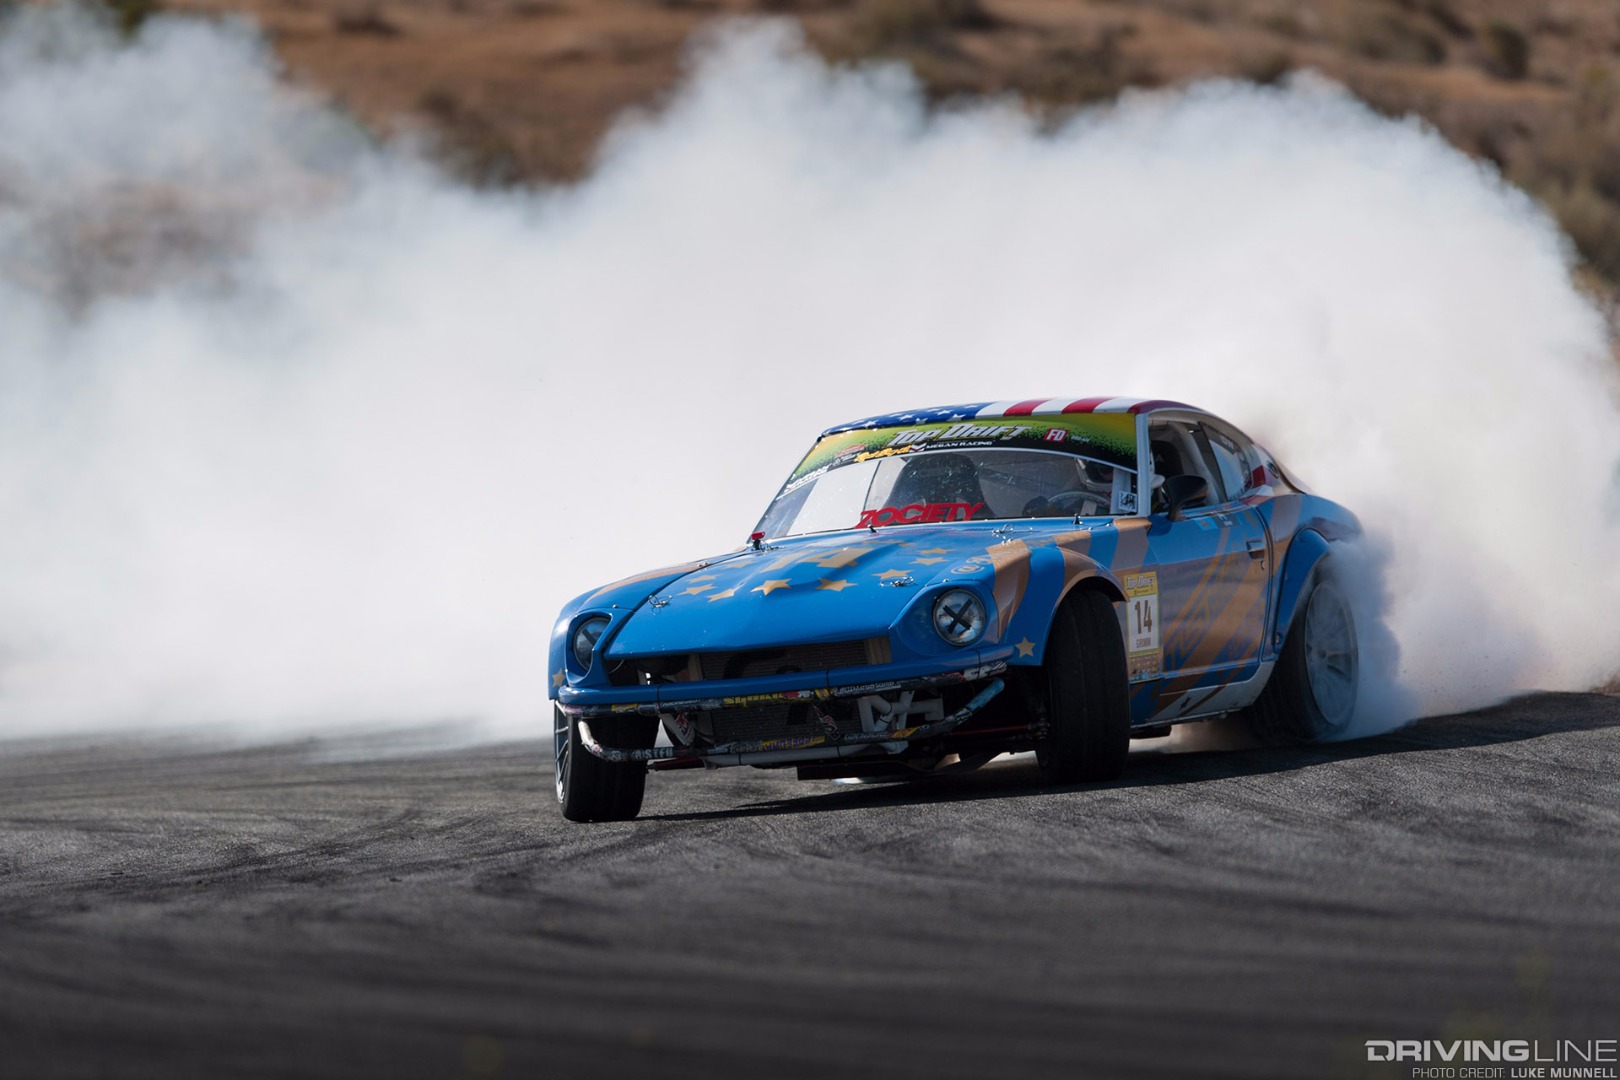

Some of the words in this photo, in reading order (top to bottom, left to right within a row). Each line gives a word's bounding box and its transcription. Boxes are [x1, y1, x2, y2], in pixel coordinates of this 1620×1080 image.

[887, 428, 942, 447] TOP
[939, 423, 1033, 441] DRIFT
[1046, 428, 1067, 442] FD
[854, 502, 984, 529] ZOCIETY
[1134, 599, 1153, 635] 14
